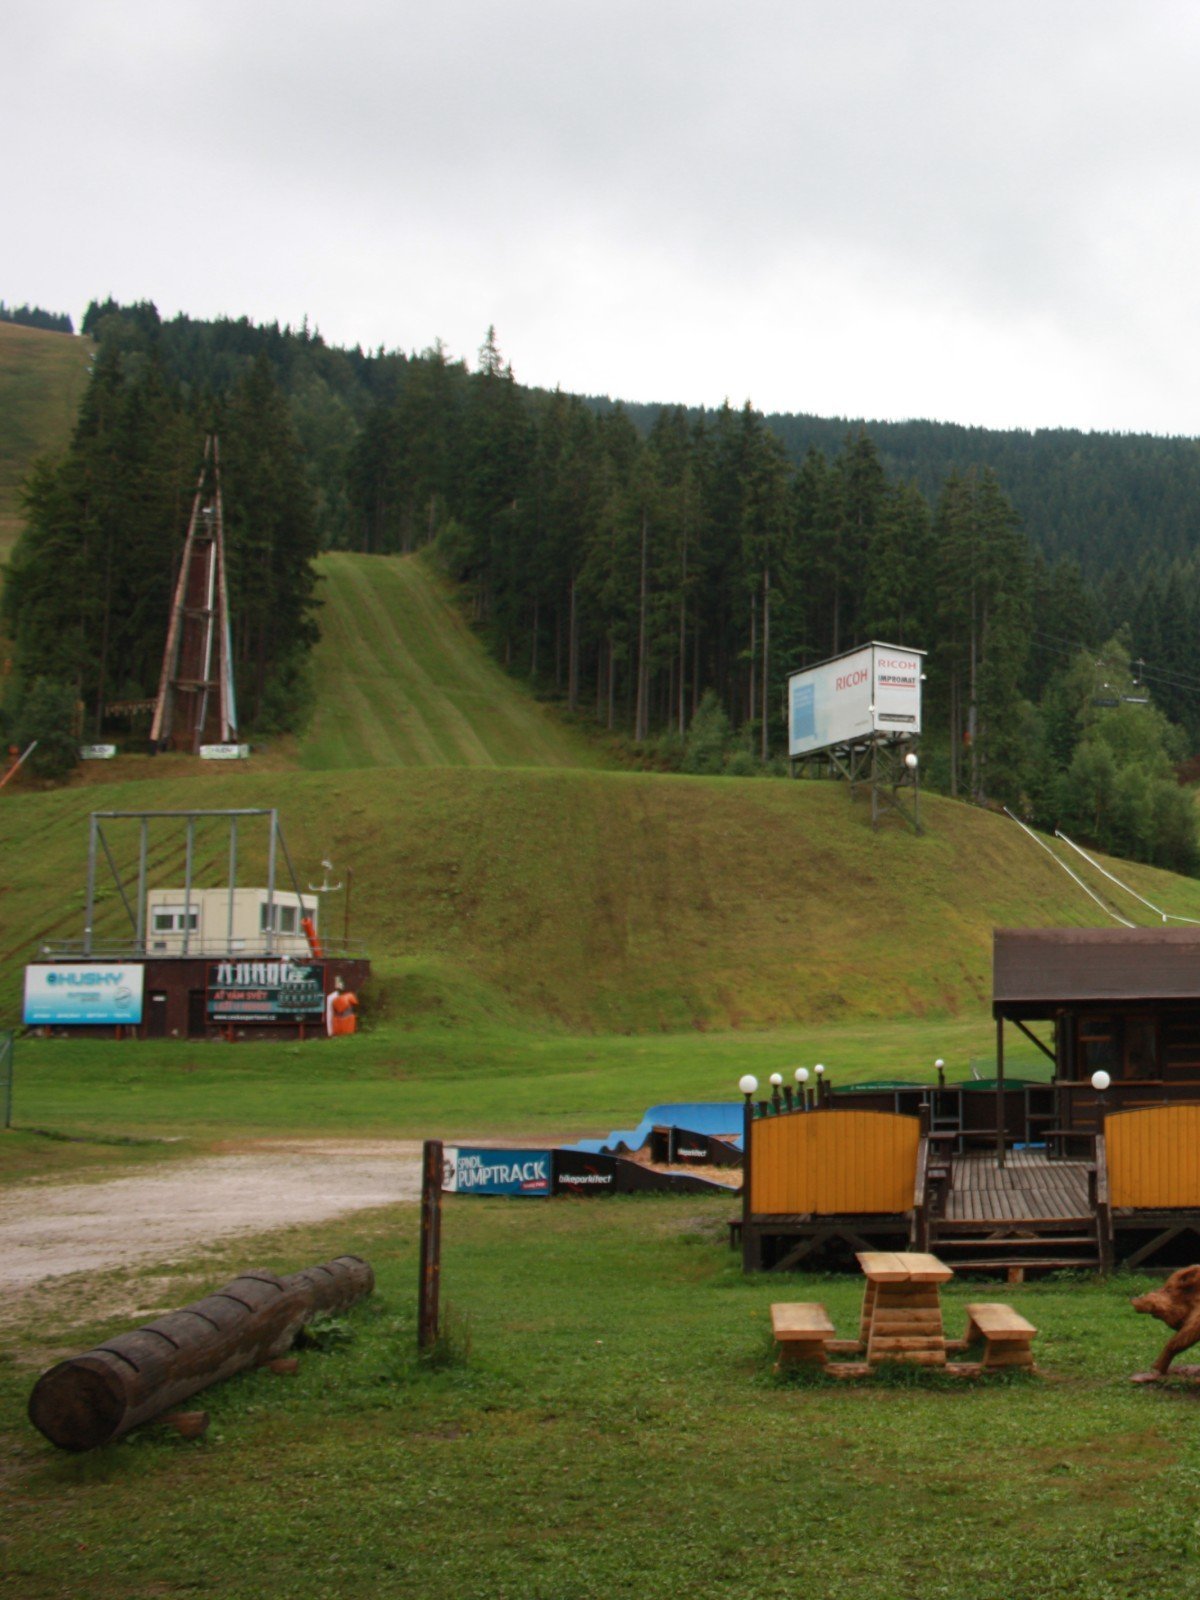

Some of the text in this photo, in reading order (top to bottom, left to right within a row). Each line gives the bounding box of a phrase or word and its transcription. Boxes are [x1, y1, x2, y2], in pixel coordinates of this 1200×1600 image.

[878, 659, 917, 670] RICOH
[836, 669, 868, 692] RICOH
[878, 675, 916, 684] IMPROMAT
[57, 972, 124, 987] HUSKY
[457, 1155, 484, 1170] SPINDL
[458, 1161, 547, 1187] PUMPTRACK
